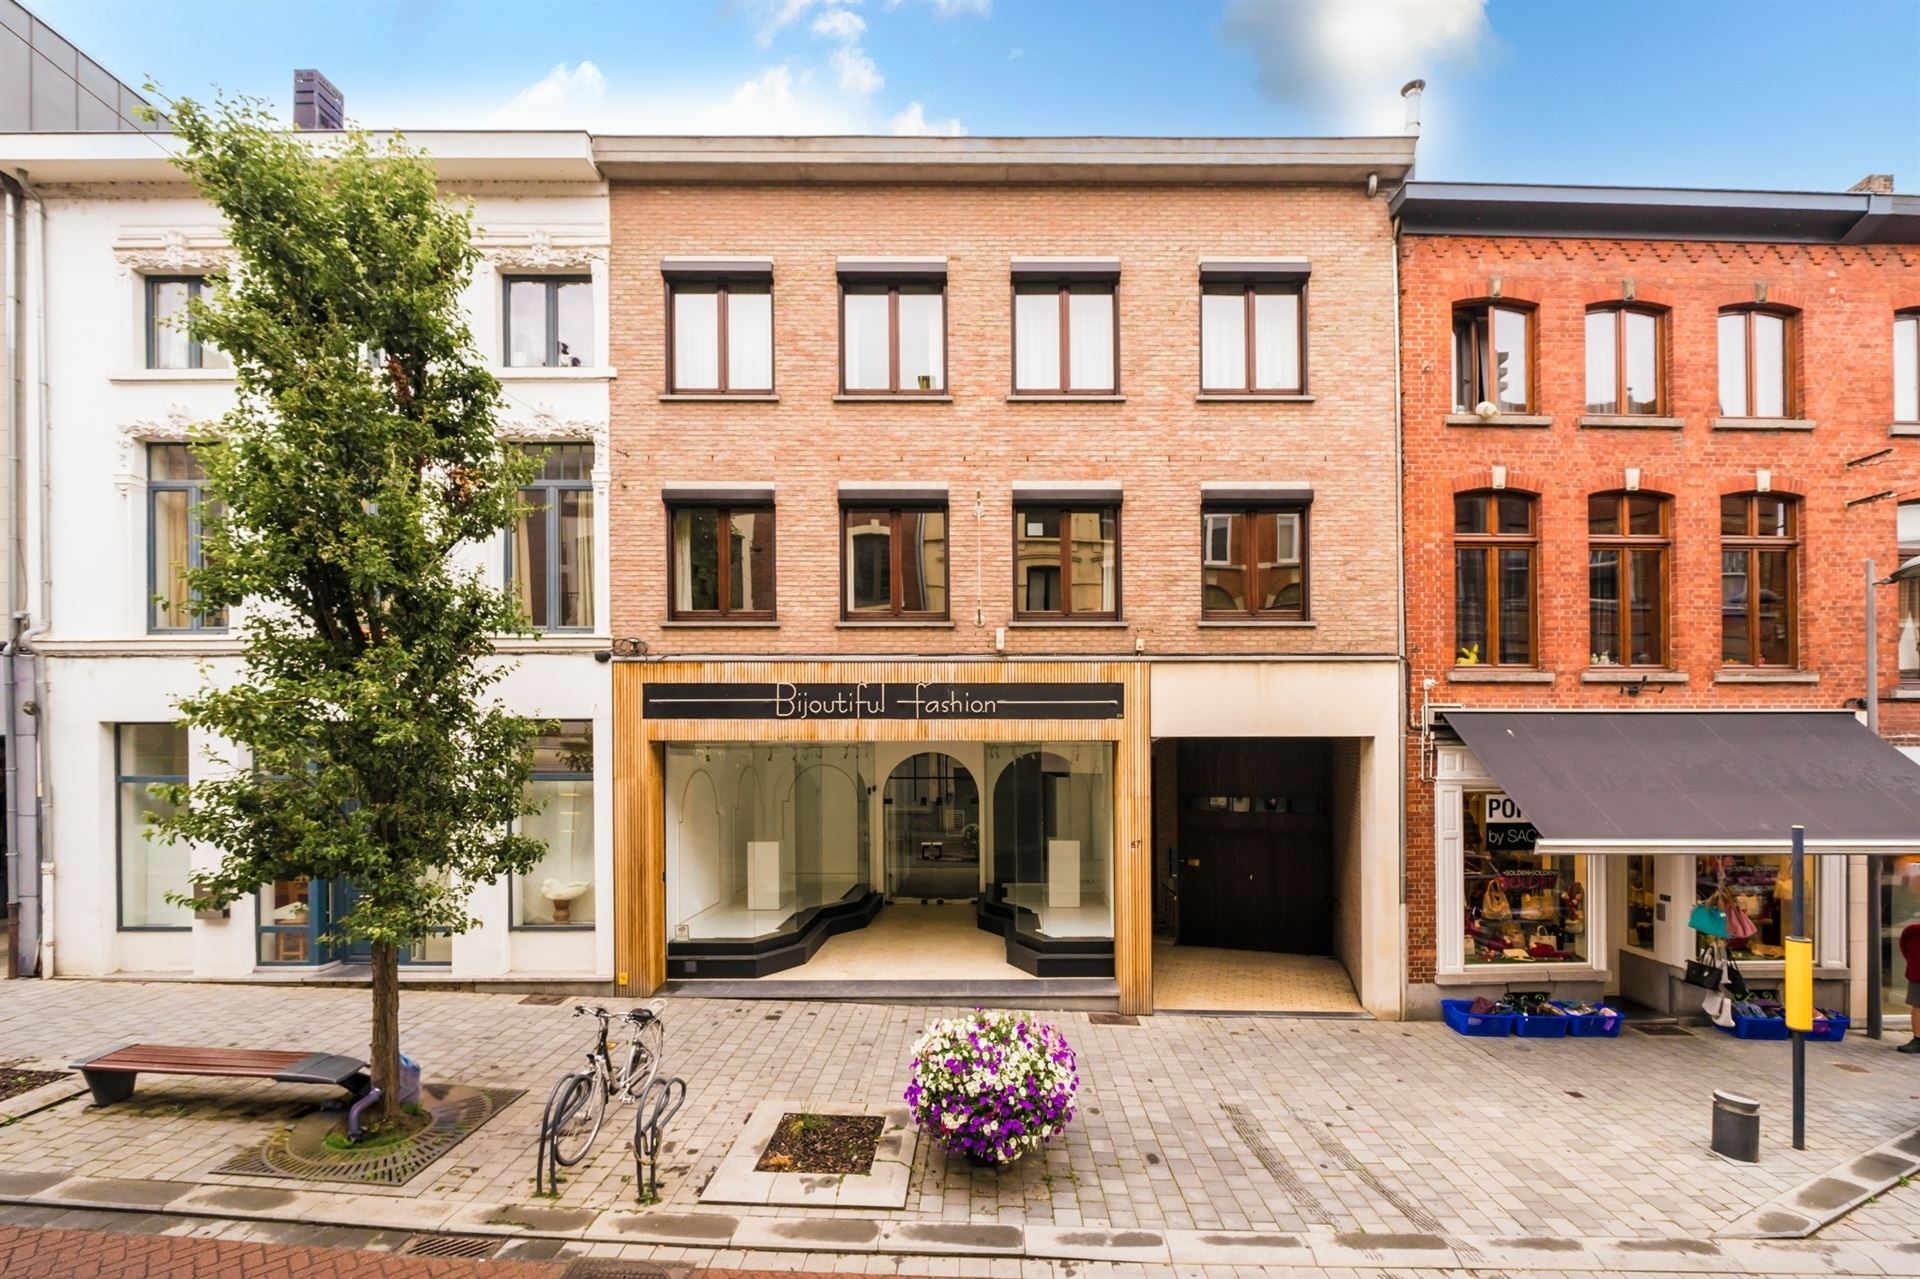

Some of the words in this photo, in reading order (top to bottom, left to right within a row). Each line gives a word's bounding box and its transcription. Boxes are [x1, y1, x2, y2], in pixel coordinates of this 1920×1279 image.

[776, 682, 885, 719] Bijoutiful
[897, 682, 996, 719] fashion
[1488, 830, 1504, 845] by
